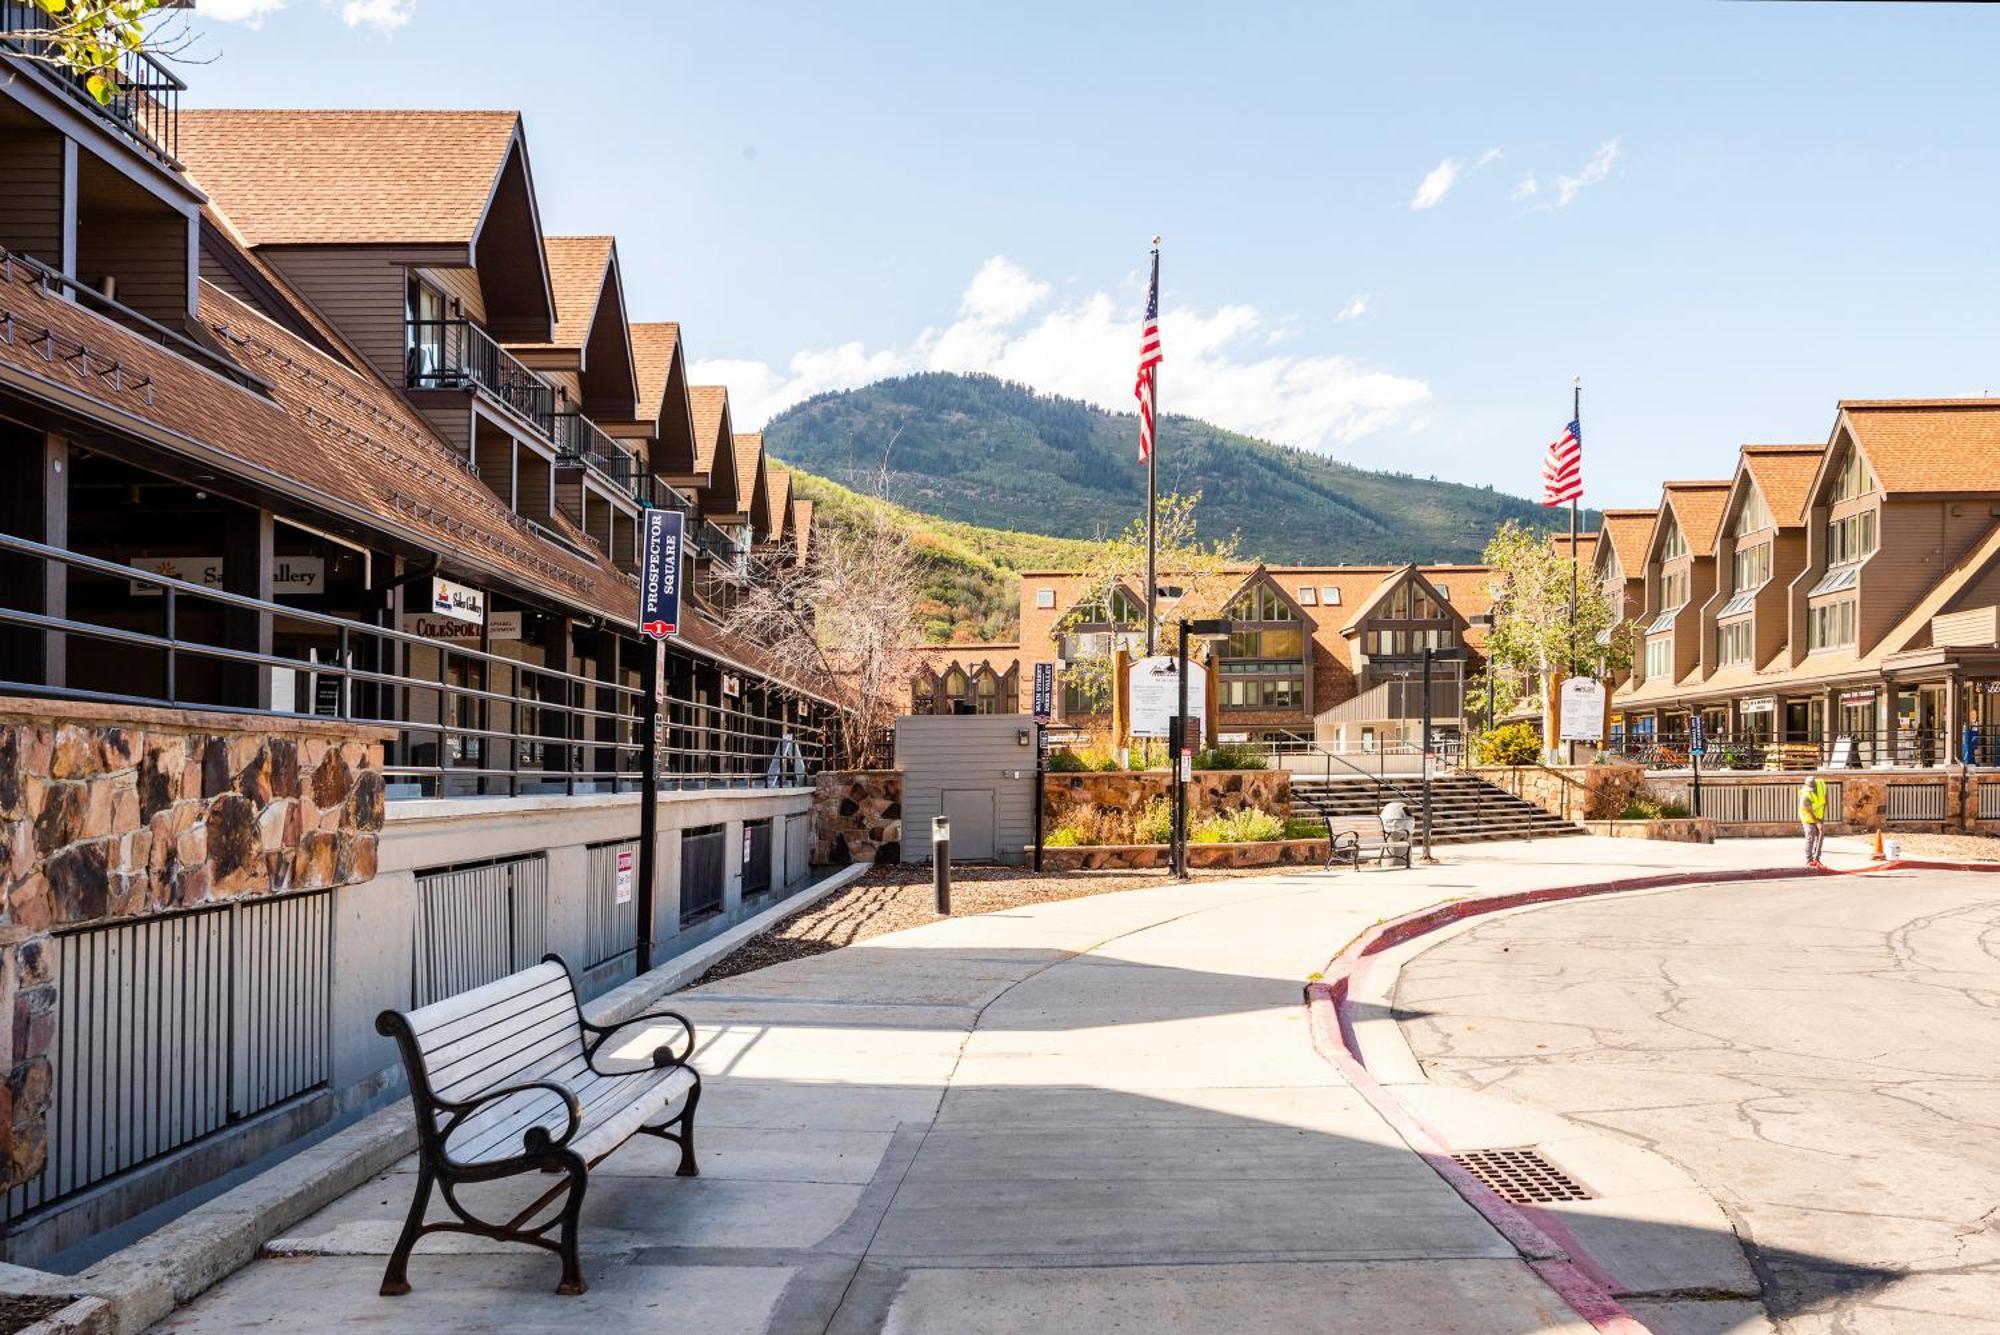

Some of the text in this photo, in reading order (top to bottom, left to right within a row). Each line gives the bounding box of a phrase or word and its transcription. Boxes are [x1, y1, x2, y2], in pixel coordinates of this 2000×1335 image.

[273, 564, 316, 586] allery
[647, 514, 662, 613] PROSPECTOR
[664, 535, 676, 595] SQUARE
[453, 592, 465, 609] Sales
[466, 596, 482, 617] Gallery
[656, 624, 662, 634] 1
